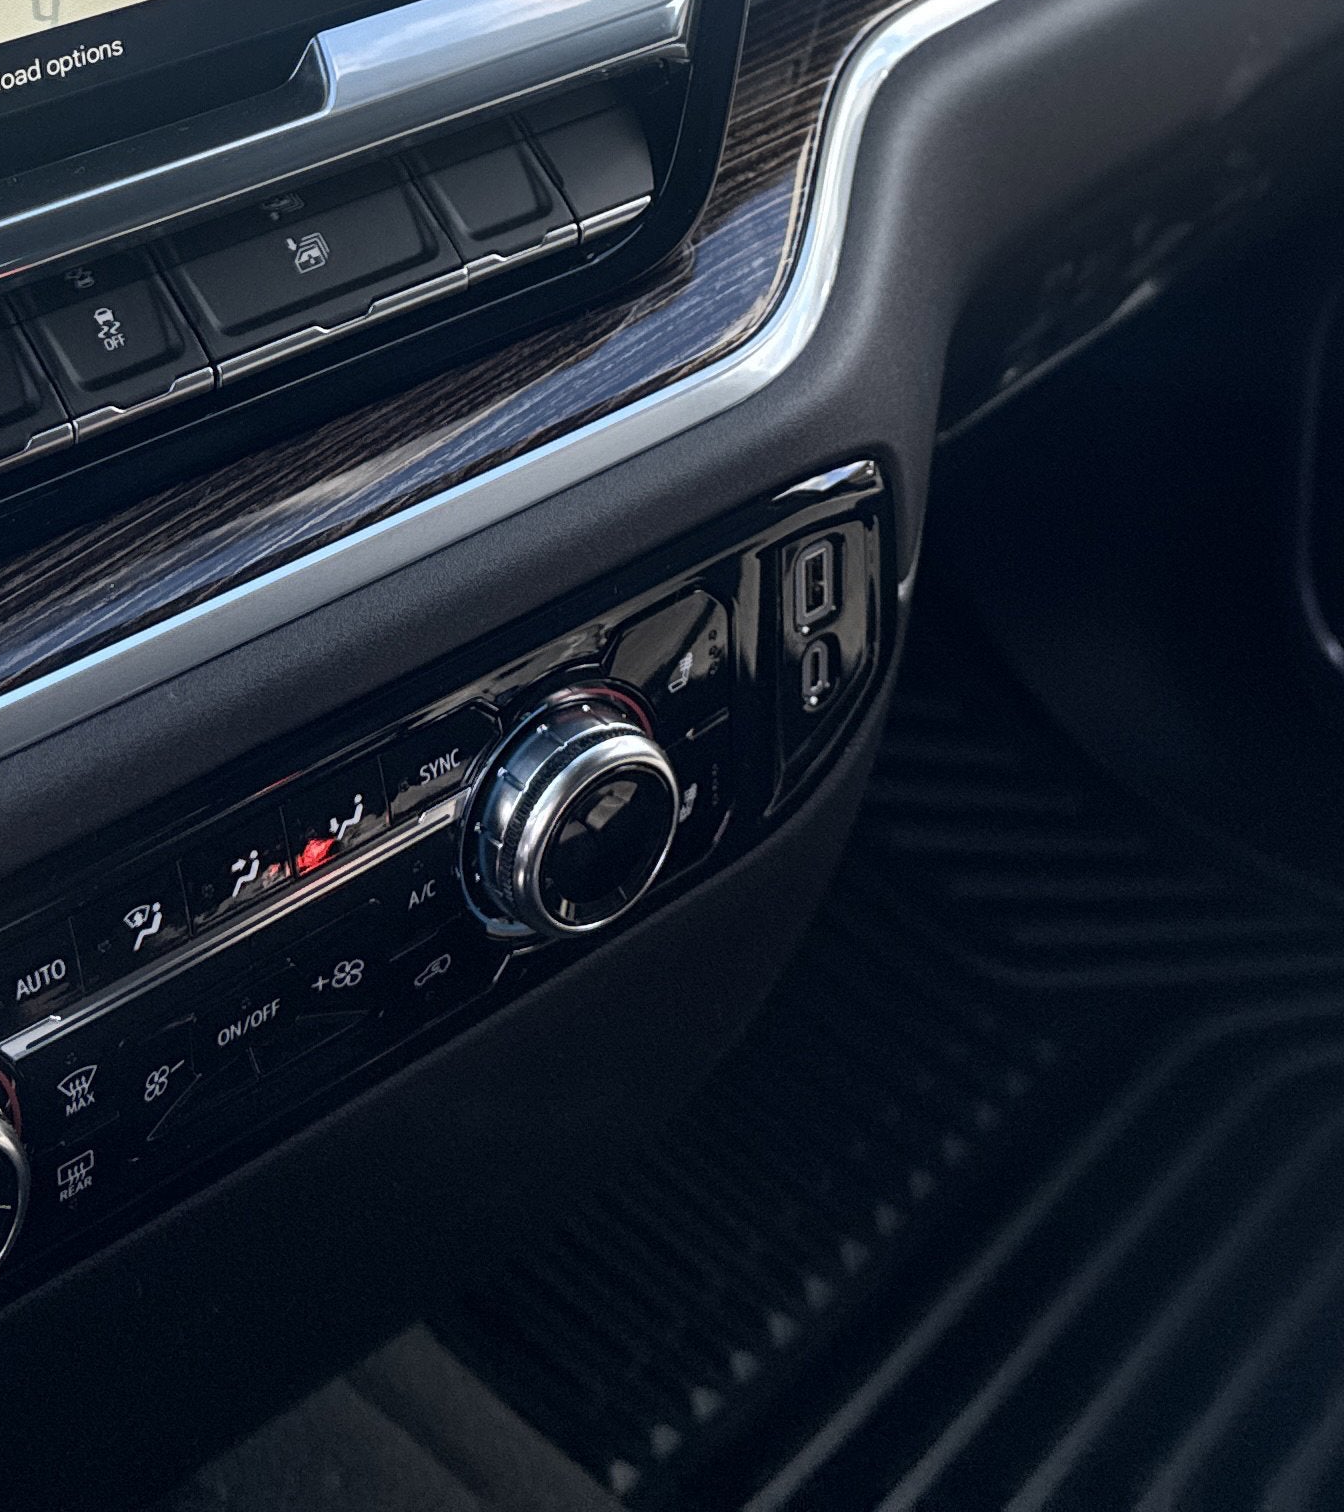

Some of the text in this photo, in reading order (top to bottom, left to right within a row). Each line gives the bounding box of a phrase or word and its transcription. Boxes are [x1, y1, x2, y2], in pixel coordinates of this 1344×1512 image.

[46, 37, 125, 77] options
[103, 333, 125, 351] OFF
[419, 748, 461, 786] SYNC
[408, 879, 436, 911] A/C
[16, 958, 67, 1001] AUTO
[217, 998, 281, 1047] ON/OFF
[65, 1092, 96, 1118] MAX
[59, 1175, 93, 1203] REAR
